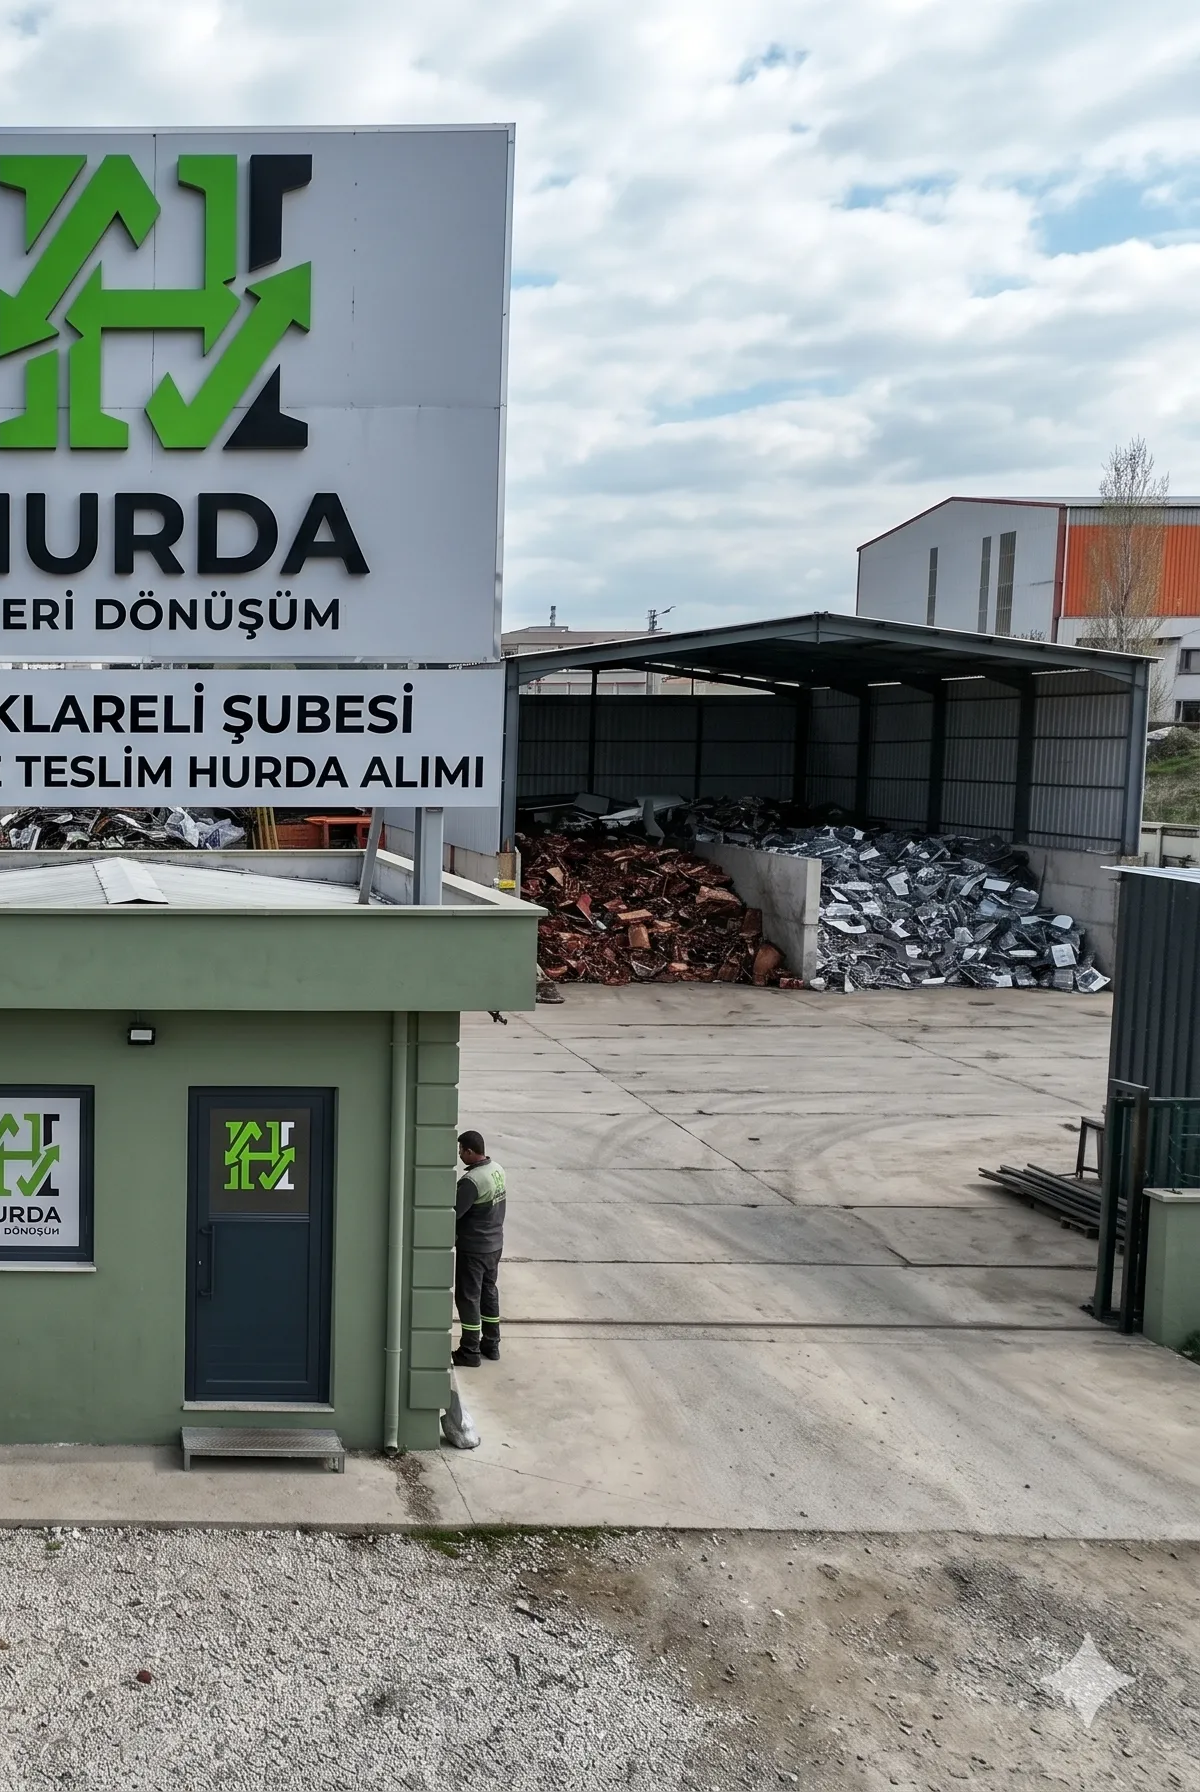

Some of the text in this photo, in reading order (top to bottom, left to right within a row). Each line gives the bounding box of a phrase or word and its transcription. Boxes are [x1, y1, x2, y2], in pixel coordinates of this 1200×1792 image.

[95, 590, 341, 640] DÖNÜŞÜM
[222, 682, 414, 745] ŞUBESİ
[15, 745, 173, 788] TESLİM
[189, 755, 349, 788] HURDA
[359, 755, 484, 788] ALIMI
